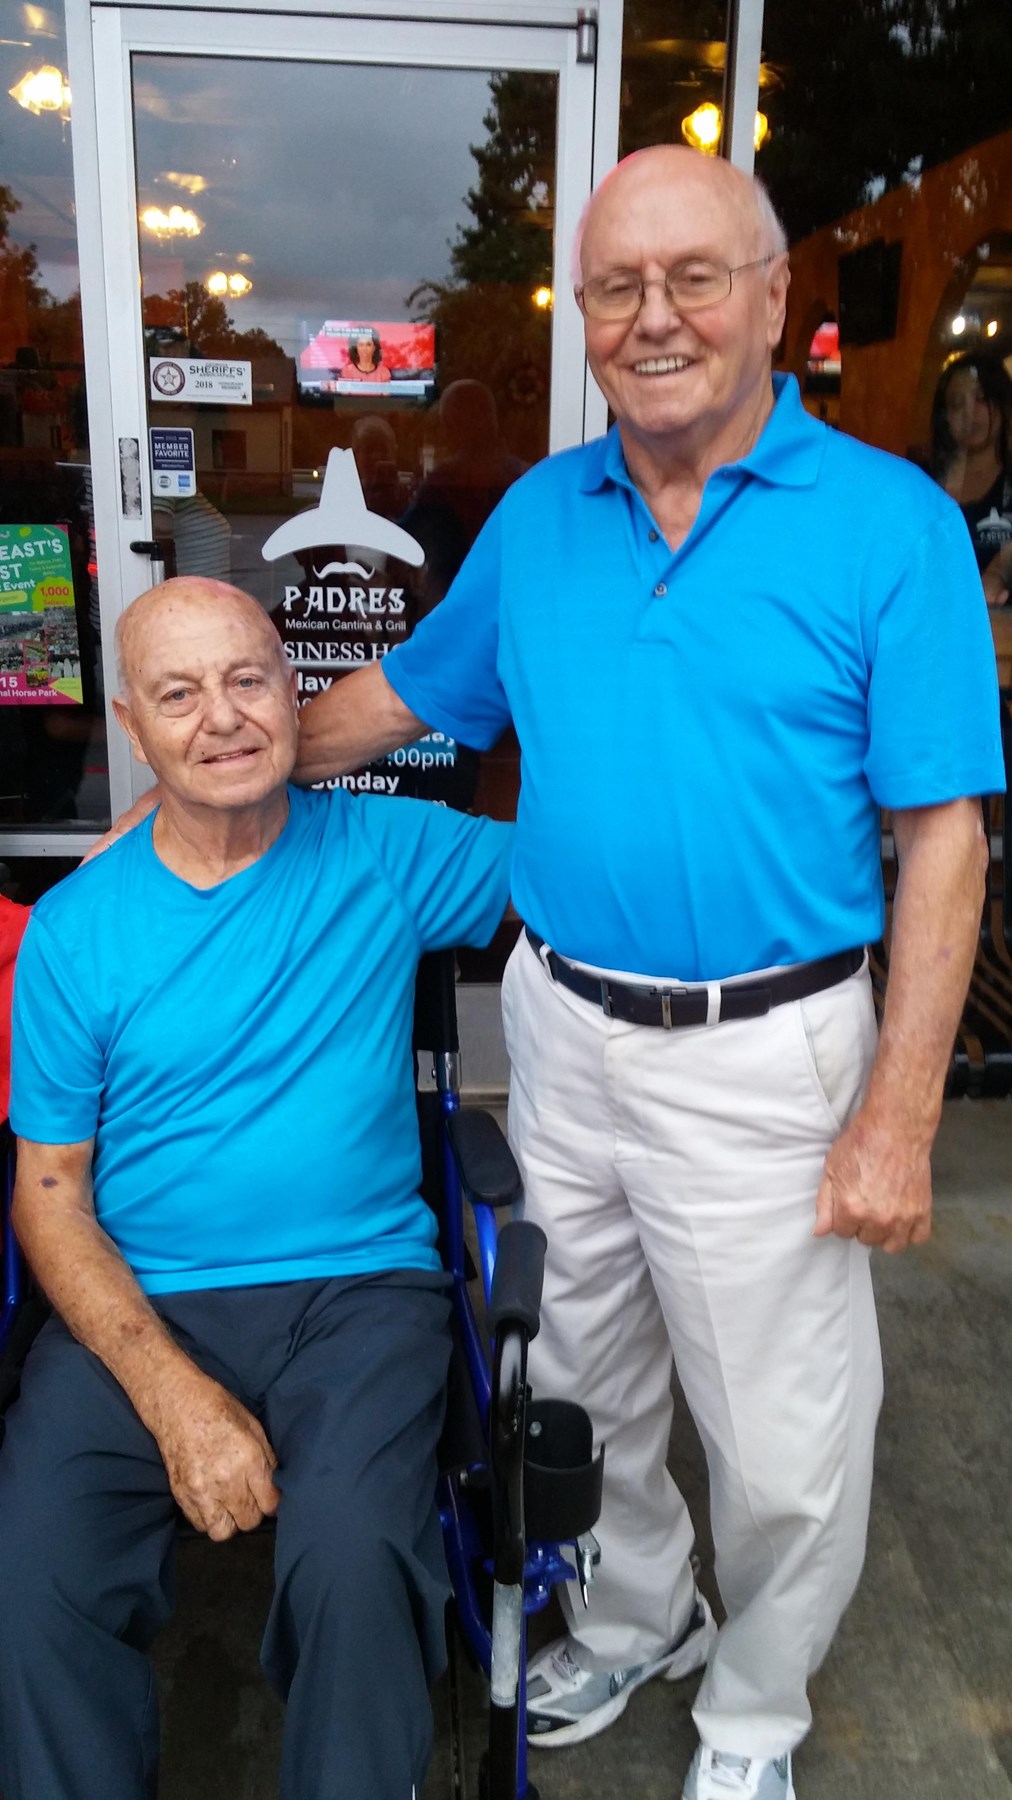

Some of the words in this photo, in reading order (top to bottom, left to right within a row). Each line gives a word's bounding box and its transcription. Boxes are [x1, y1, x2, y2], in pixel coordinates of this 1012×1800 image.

[189, 365, 246, 376] SHERIFFS'
[195, 380, 213, 388] 2018
[154, 442, 189, 450] MEMBER
[154, 449, 190, 458] FAVORITE
[3, 579, 36, 591] Event
[40, 586, 69, 597] 1,000
[283, 585, 406, 618] PADRES
[285, 619, 330, 630] Mexican
[332, 619, 373, 631] Cantina
[375, 620, 383, 631] &
[385, 620, 407, 632] Grill
[371, 642, 400, 661] H
[0, 676, 18, 688] 15
[12, 689, 38, 697] Horse
[38, 689, 58, 697] Park
